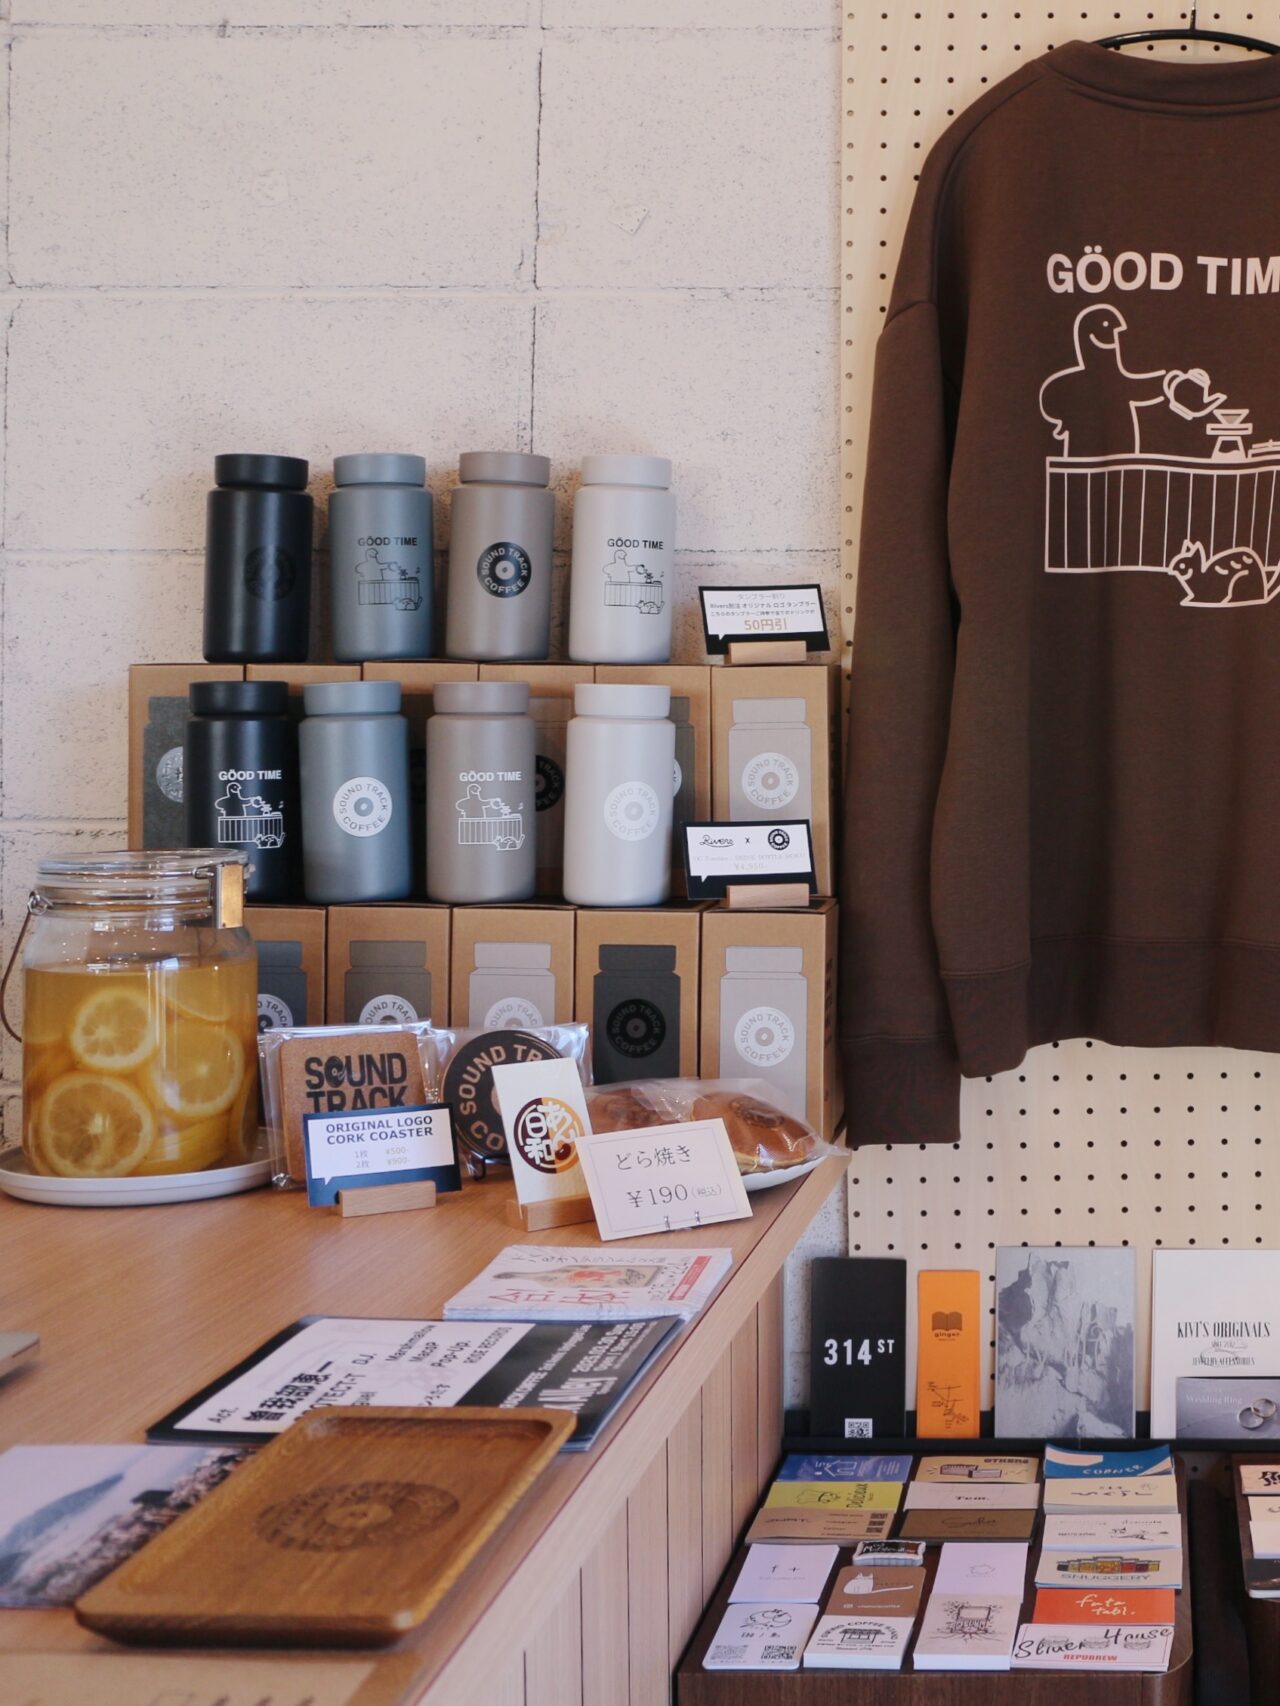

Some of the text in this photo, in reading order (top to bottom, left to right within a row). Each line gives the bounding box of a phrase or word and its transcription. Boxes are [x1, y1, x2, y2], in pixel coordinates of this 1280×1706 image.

[1046, 245, 1184, 293] GÖOD
[394, 536, 418, 547] TIME
[607, 537, 664, 550] GÖOD TIME
[481, 547, 528, 577] SOUND TRACK
[484, 576, 525, 594] COFFEE
[743, 617, 788, 631] 50円引
[218, 768, 283, 781] GÖOD TIME
[459, 770, 522, 782] GÖOD TIME
[748, 758, 795, 787] SOUND TRACK
[339, 783, 388, 814] SOUND TRACK
[609, 787, 658, 817] SOUND TRACK
[750, 788, 790, 805] COFFEE
[343, 815, 385, 832] COFFEE
[613, 818, 655, 836] COFFEE
[365, 1001, 412, 1024] OUND TRAC
[491, 1003, 538, 1027] OUND TRAC
[612, 1004, 661, 1035] SOUND TRACK
[741, 1013, 790, 1044] SOUND TRACK
[615, 1035, 658, 1053] COFFEE
[744, 1044, 786, 1062] COFFEE
[304, 1052, 407, 1090] SOUND
[458, 1045, 507, 1116] SOUND
[326, 1115, 433, 1134] ORIGINAL LOGO
[327, 1126, 433, 1146] CORK COASTER
[523, 1111, 556, 1165] 日和
[616, 1144, 691, 1171] どら焼き
[626, 1184, 688, 1208] ¥190
[933, 1330, 961, 1339] ginger
[1212, 1321, 1271, 1338] ORIGINALS
[352, 1352, 378, 1366] DJ.
[430, 1340, 472, 1368] Pop-Up.
[823, 1338, 895, 1366] 314 ST
[208, 1406, 239, 1424] Act.
[1060, 1573, 1151, 1581] SNUGGERY
[847, 1620, 883, 1628] COFFEE
